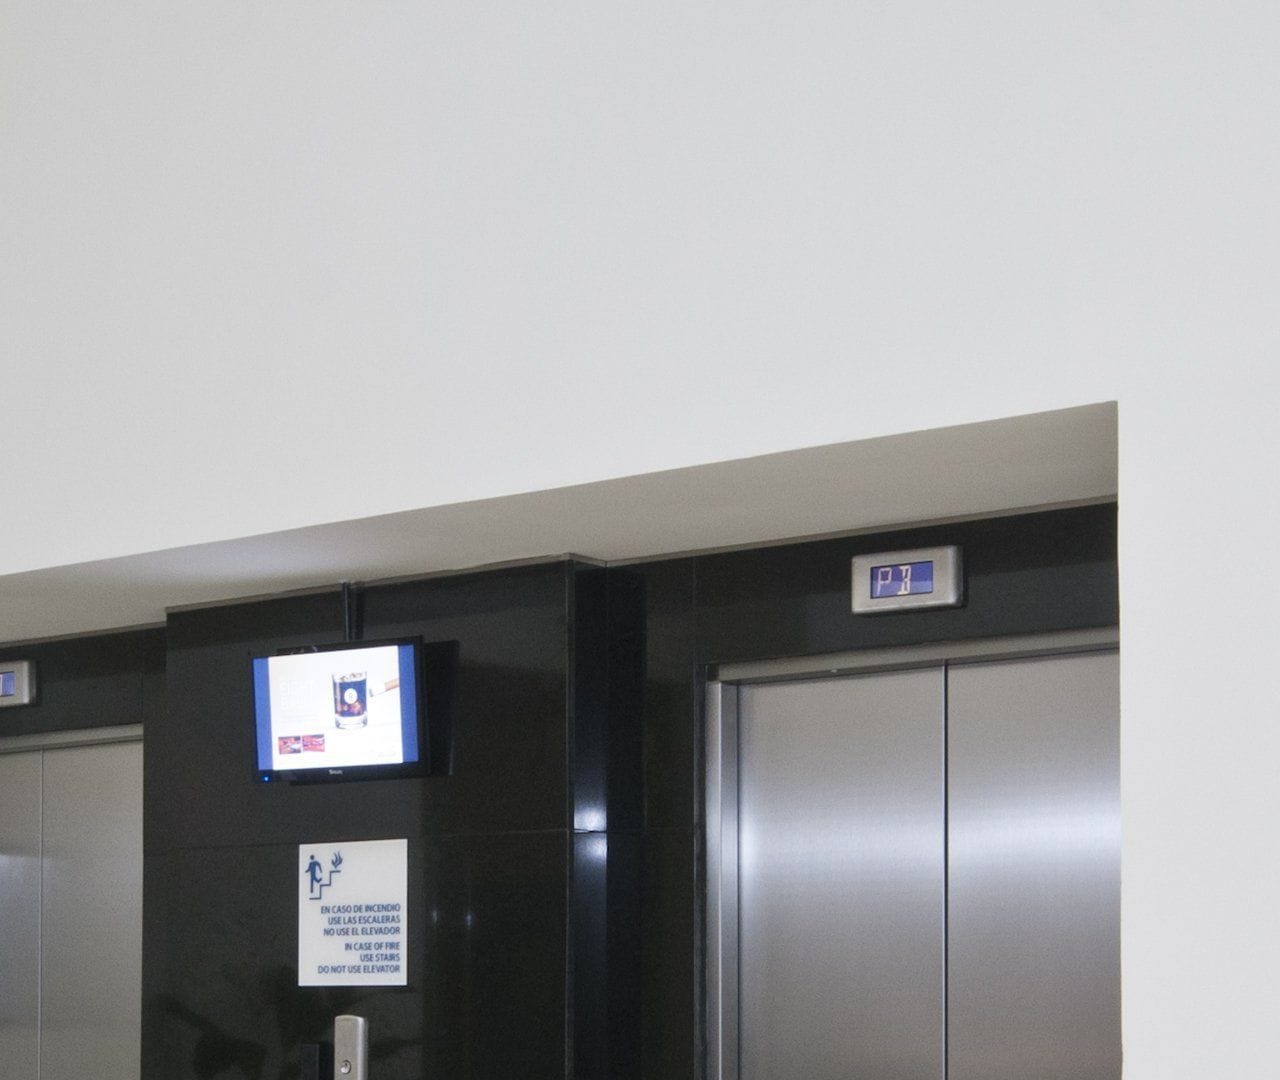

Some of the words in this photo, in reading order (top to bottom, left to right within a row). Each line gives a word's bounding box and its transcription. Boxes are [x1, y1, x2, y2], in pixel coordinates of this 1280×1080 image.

[321, 905, 330, 914] EN
[331, 905, 352, 914] CASO
[353, 904, 363, 913] DE
[365, 903, 401, 912] INCENDIO
[328, 917, 342, 925] USE
[343, 917, 357, 925] LAS
[358, 915, 401, 924] ESCALERAS
[323, 928, 335, 936] NO
[336, 928, 350, 936] USE
[351, 927, 359, 935] EL
[361, 926, 401, 935] ELEVADOR
[344, 943, 352, 951] IN
[353, 942, 372, 951] CASE
[373, 942, 384, 950] OF
[385, 942, 401, 950] FIRE
[360, 954, 373, 962] USE
[375, 953, 400, 962] STAIRS
[318, 966, 330, 974] DO
[331, 966, 347, 974] NOT
[348, 965, 361, 974] USE
[363, 965, 401, 973] ELEVATOR
